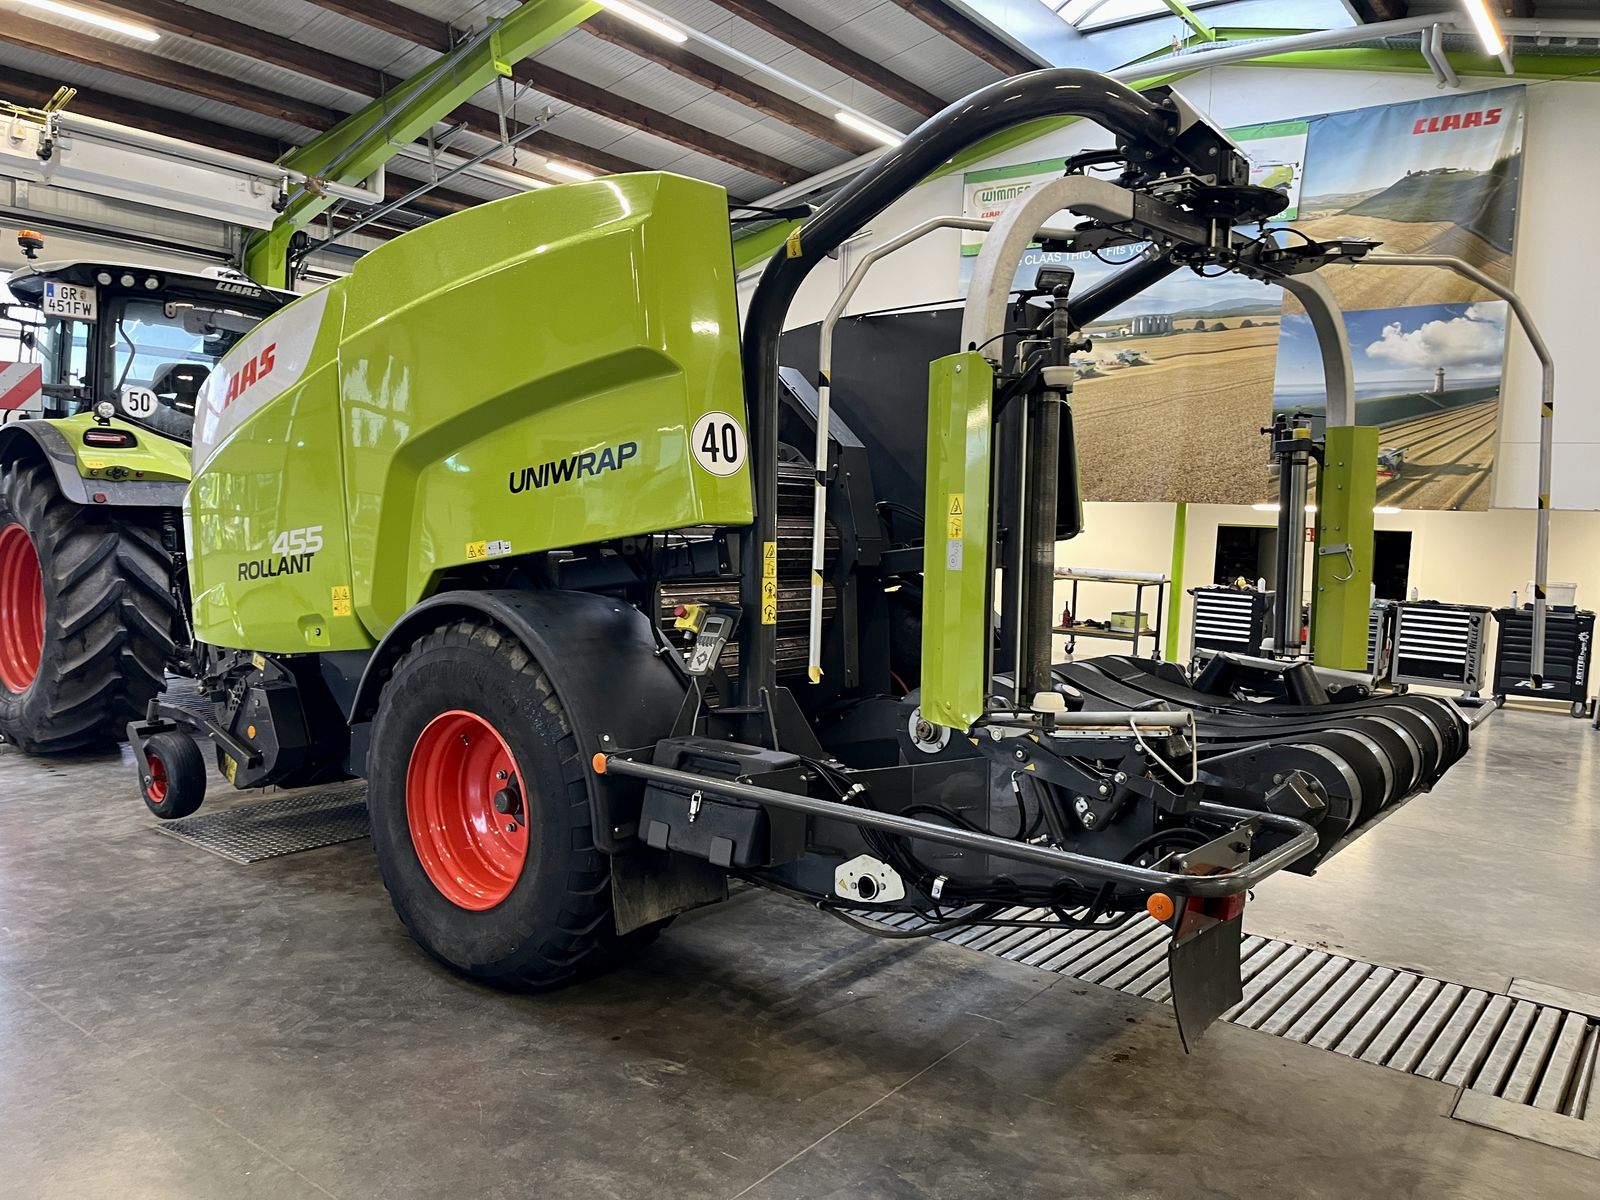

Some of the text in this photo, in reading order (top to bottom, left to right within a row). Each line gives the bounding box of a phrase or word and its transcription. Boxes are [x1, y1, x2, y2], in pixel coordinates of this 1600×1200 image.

[1412, 107, 1503, 135] CLAAS
[981, 185, 1031, 202] WIMME
[1024, 253, 1062, 266] CLAAS
[1106, 245, 1126, 257] Fits
[61, 286, 77, 300] GR
[216, 282, 262, 298] CLAAS
[49, 299, 91, 315] 451FW
[129, 391, 150, 412] 50
[701, 422, 737, 463] 40
[509, 441, 637, 494] UNIWRAP
[271, 525, 323, 557] 455
[238, 552, 315, 582] ROLLANT
